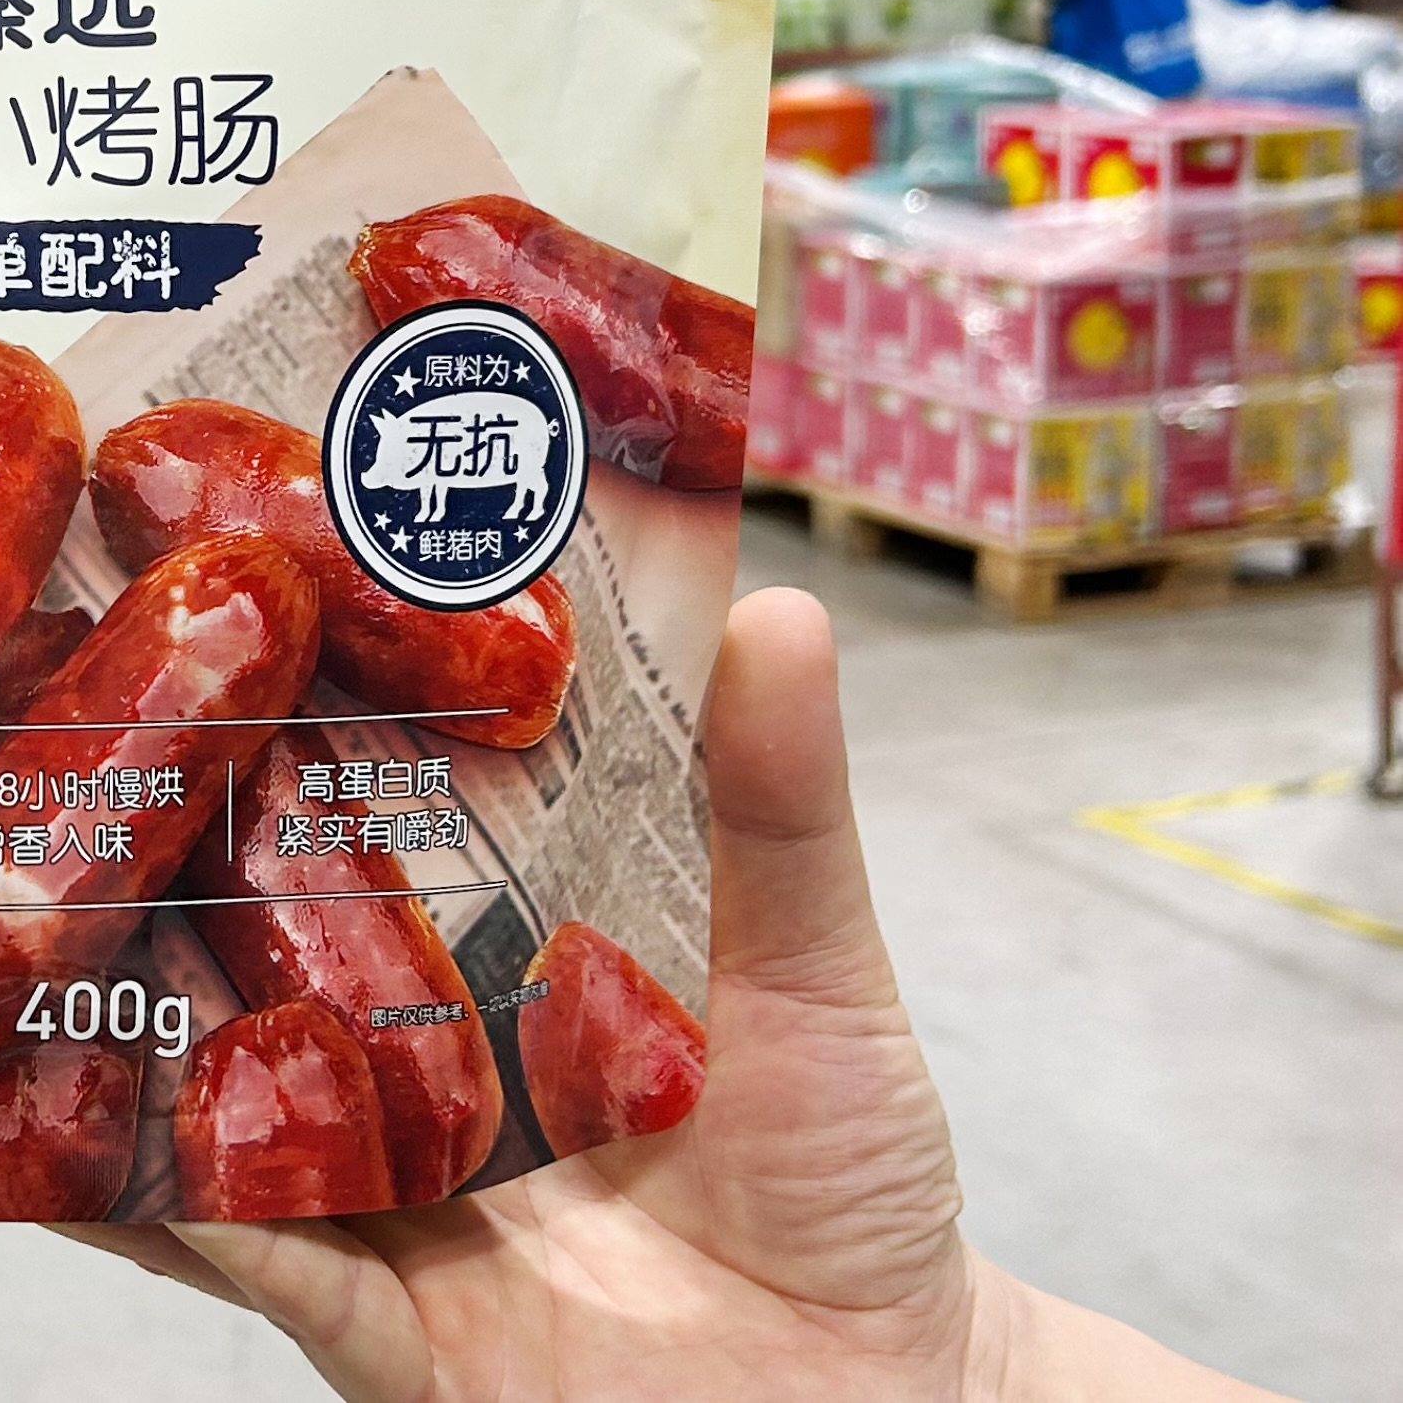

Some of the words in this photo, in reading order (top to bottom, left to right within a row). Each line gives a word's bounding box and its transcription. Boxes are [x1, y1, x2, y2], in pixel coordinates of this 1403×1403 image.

[423, 353, 510, 388] 原料为
[405, 413, 519, 478] 无抗
[418, 527, 502, 563] 鲜猪肉
[297, 756, 452, 803] 高蛋白质
[276, 807, 469, 856] 紧实有嚼劲
